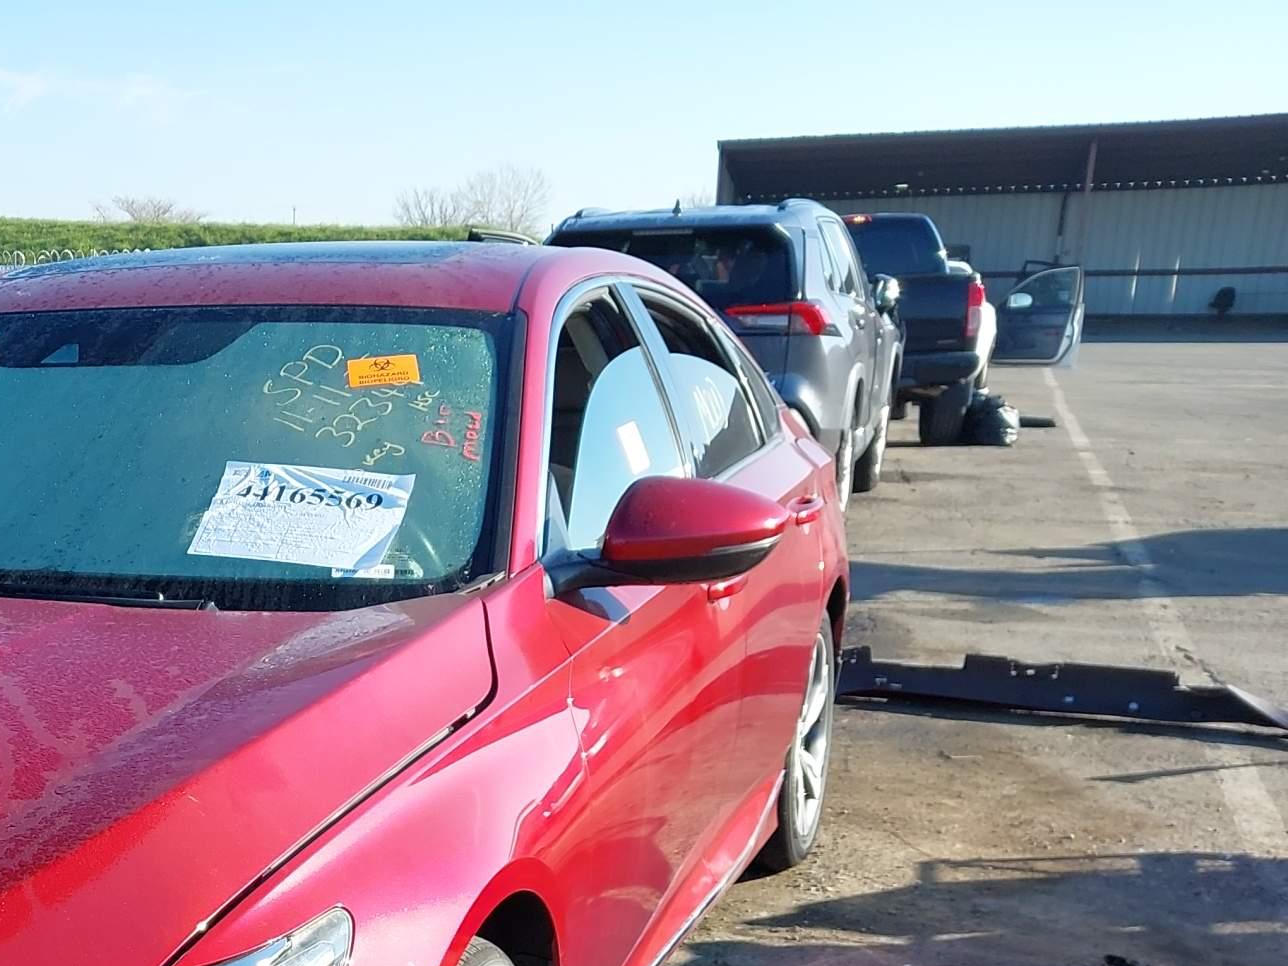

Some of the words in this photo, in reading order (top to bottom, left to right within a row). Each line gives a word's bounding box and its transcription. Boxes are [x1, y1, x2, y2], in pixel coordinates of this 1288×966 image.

[263, 344, 344, 406] SPD
[358, 371, 409, 380] BIOHAZARD
[236, 484, 384, 511] 44165569
